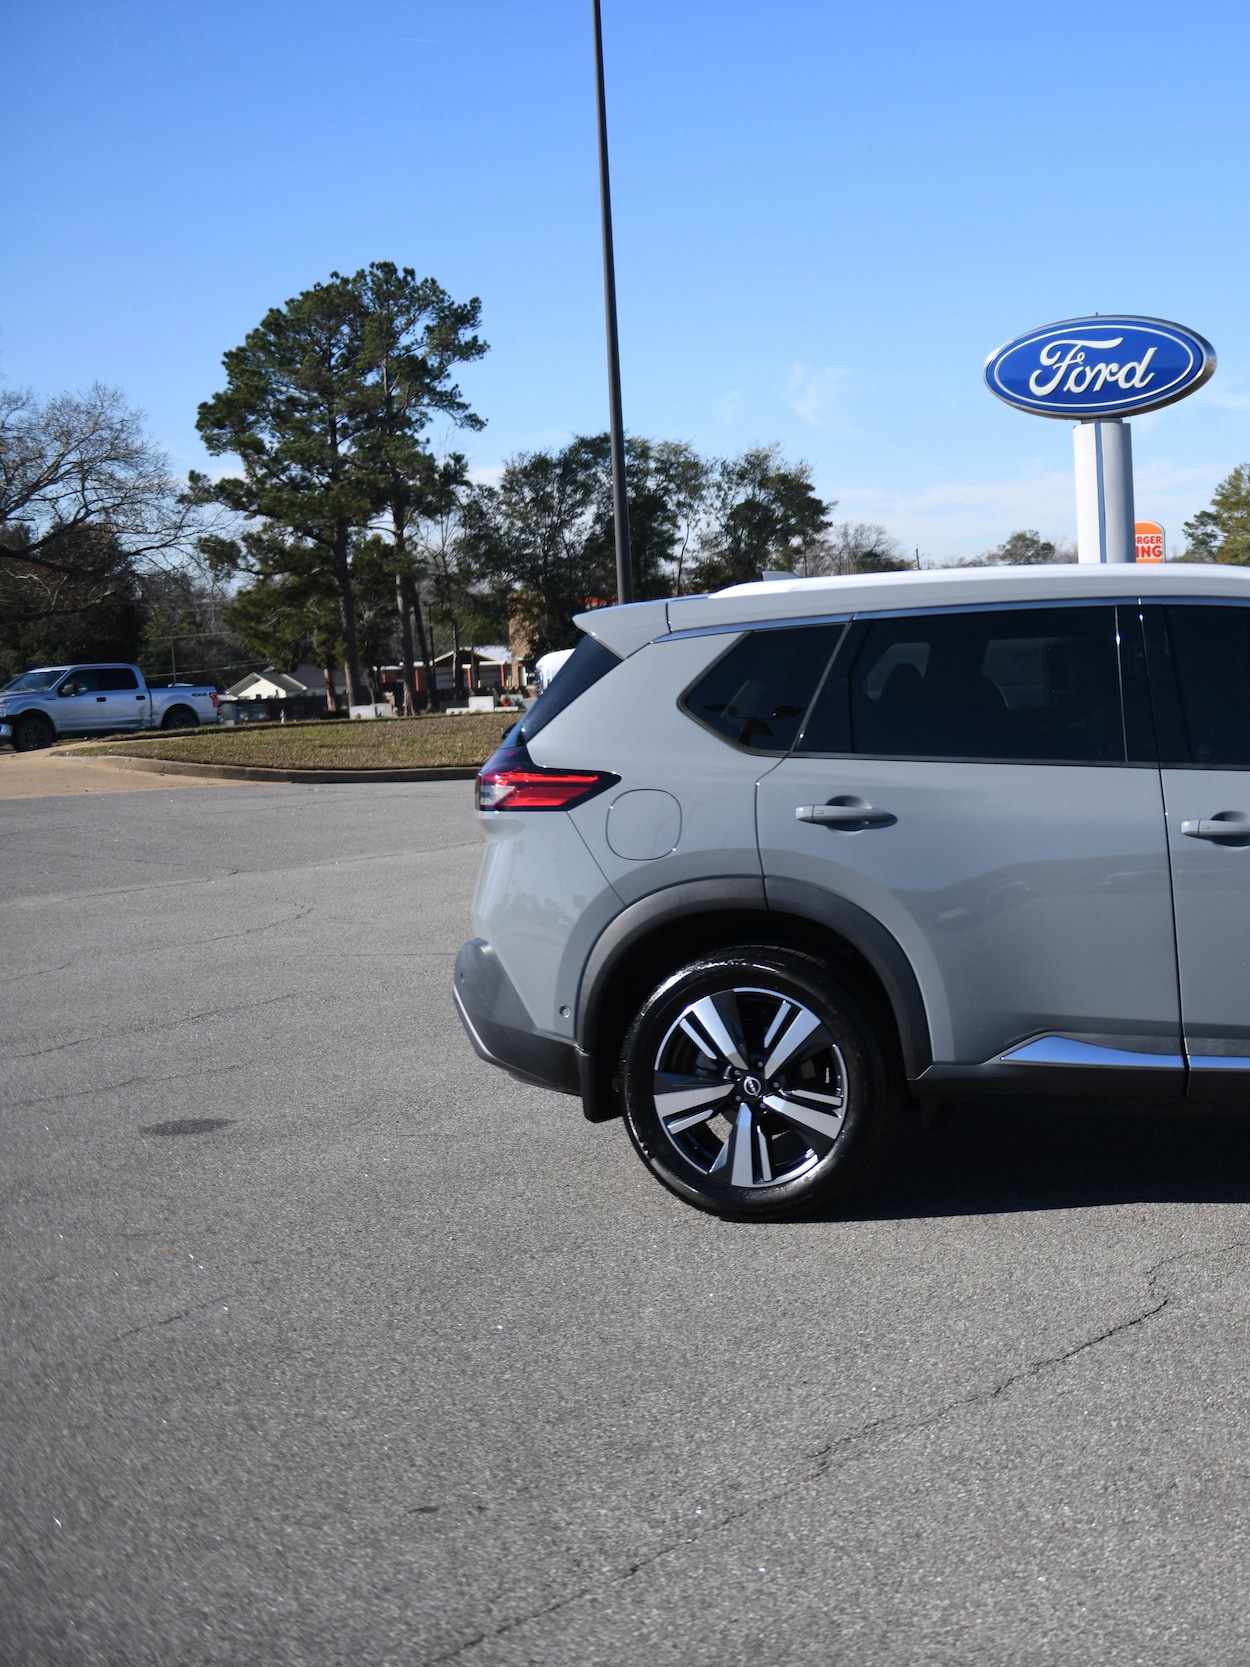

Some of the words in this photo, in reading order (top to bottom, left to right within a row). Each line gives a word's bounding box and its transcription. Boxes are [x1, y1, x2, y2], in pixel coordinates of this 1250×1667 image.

[1029, 337, 1158, 397] Ford
[1136, 535, 1162, 545] RGER
[1136, 545, 1163, 558] ING
